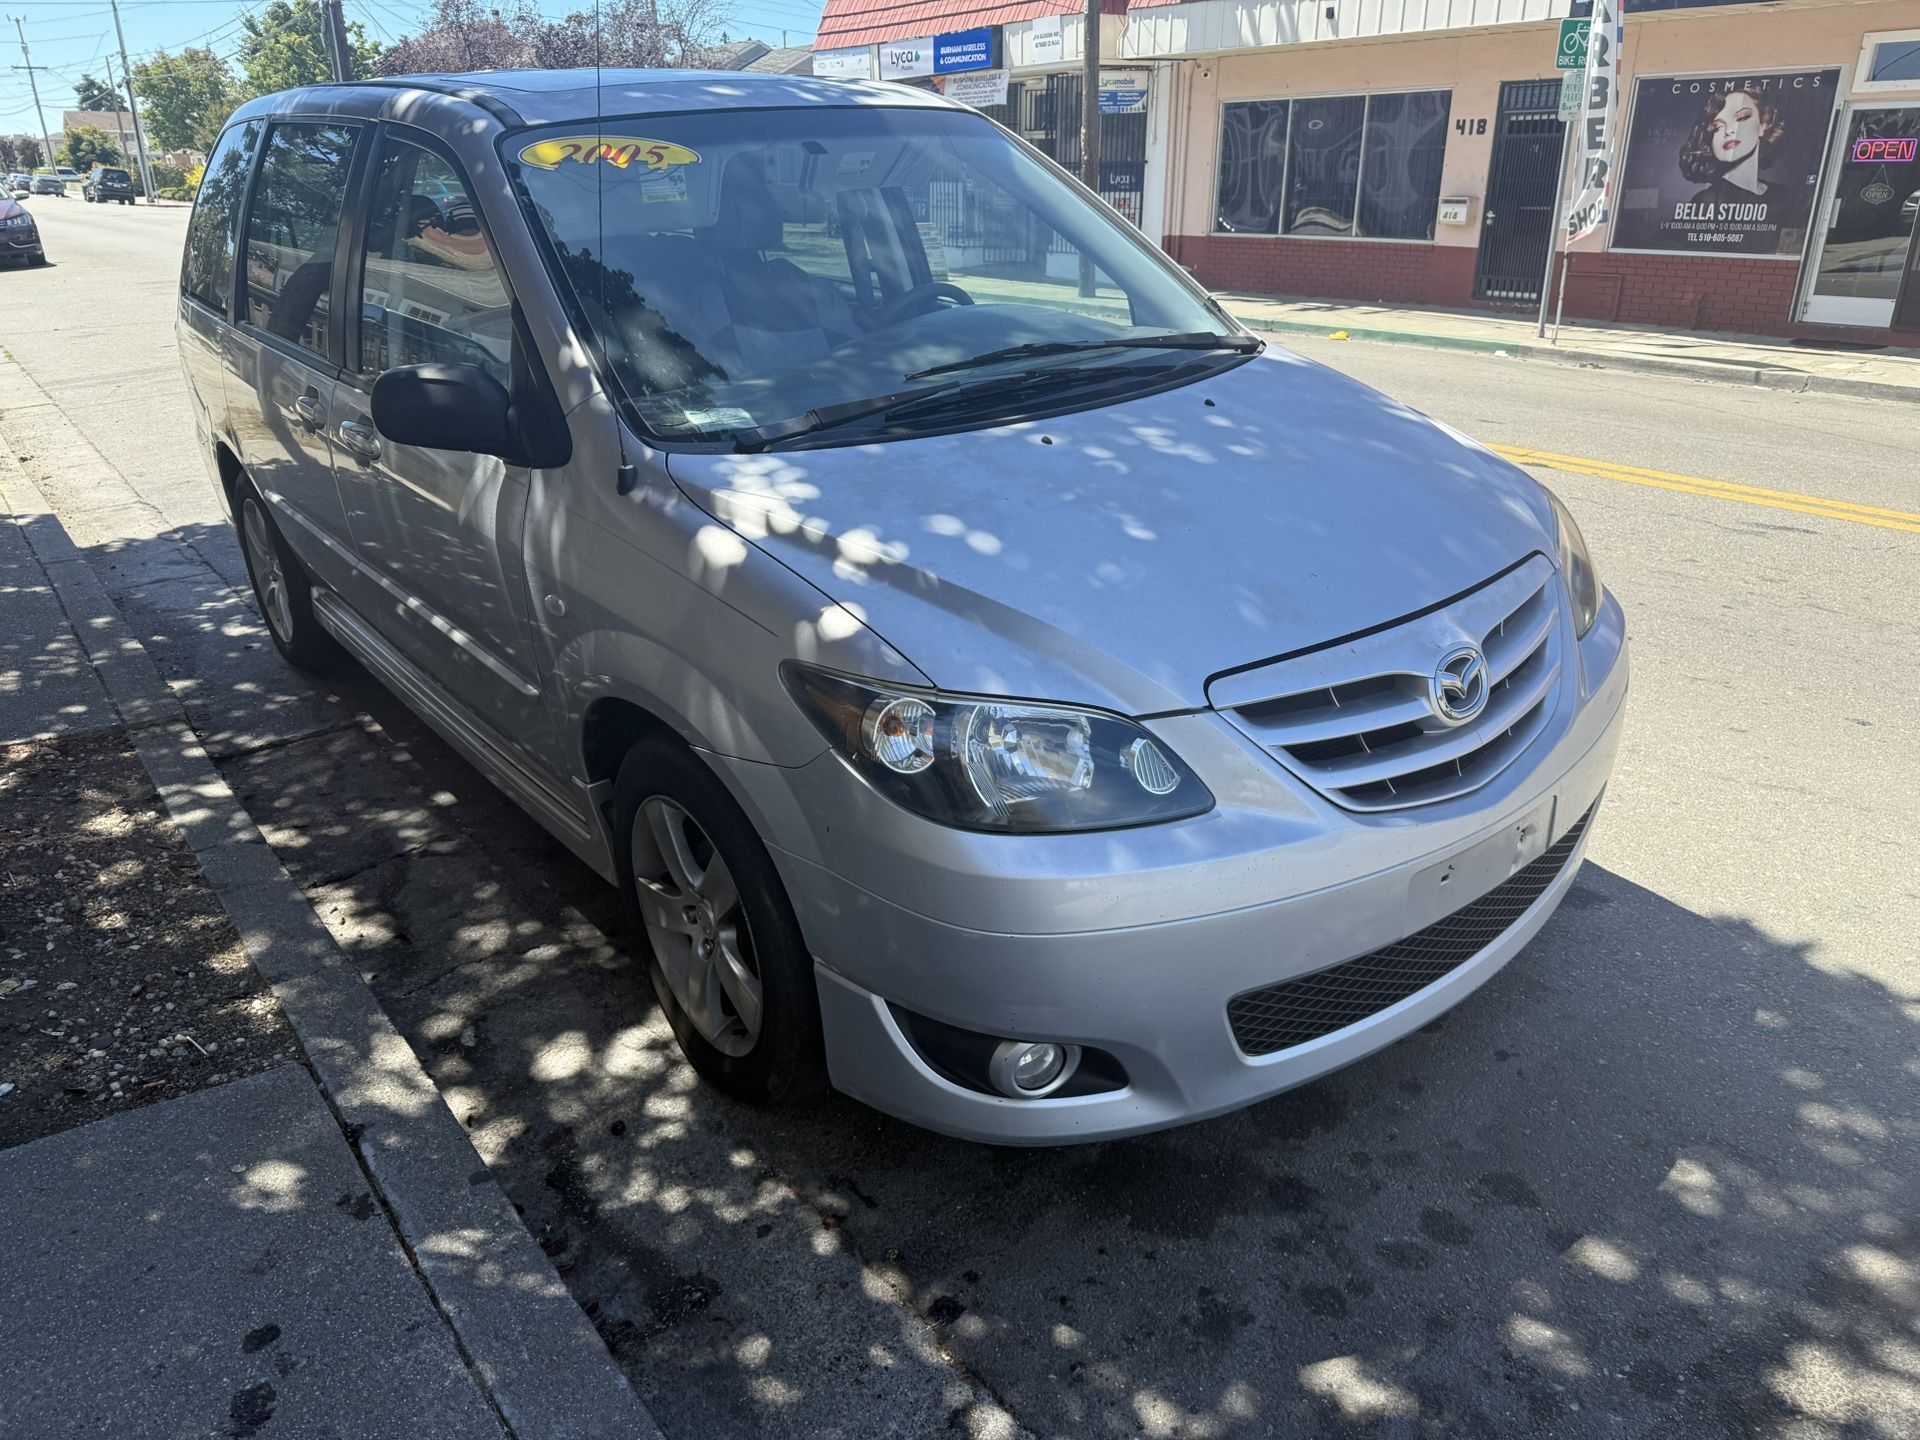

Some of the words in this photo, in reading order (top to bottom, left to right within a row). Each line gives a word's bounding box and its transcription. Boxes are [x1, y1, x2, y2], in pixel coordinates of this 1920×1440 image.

[962, 43, 986, 52] WIRELESS
[890, 50, 913, 67] Lyca
[944, 54, 987, 64] COMMUNICATION
[1559, 55, 1576, 65] BIKE
[1672, 76, 1821, 94] COSMETICS
[1456, 119, 1487, 135] 418
[550, 143, 670, 166] 2005
[1857, 141, 1914, 159] OPEN
[1865, 191, 1889, 200] OPEN
[1443, 210, 1459, 220] 418
[1674, 203, 1714, 220] BELLA
[1717, 203, 1768, 221] STUDIO
[1687, 232, 1698, 241] TEL
